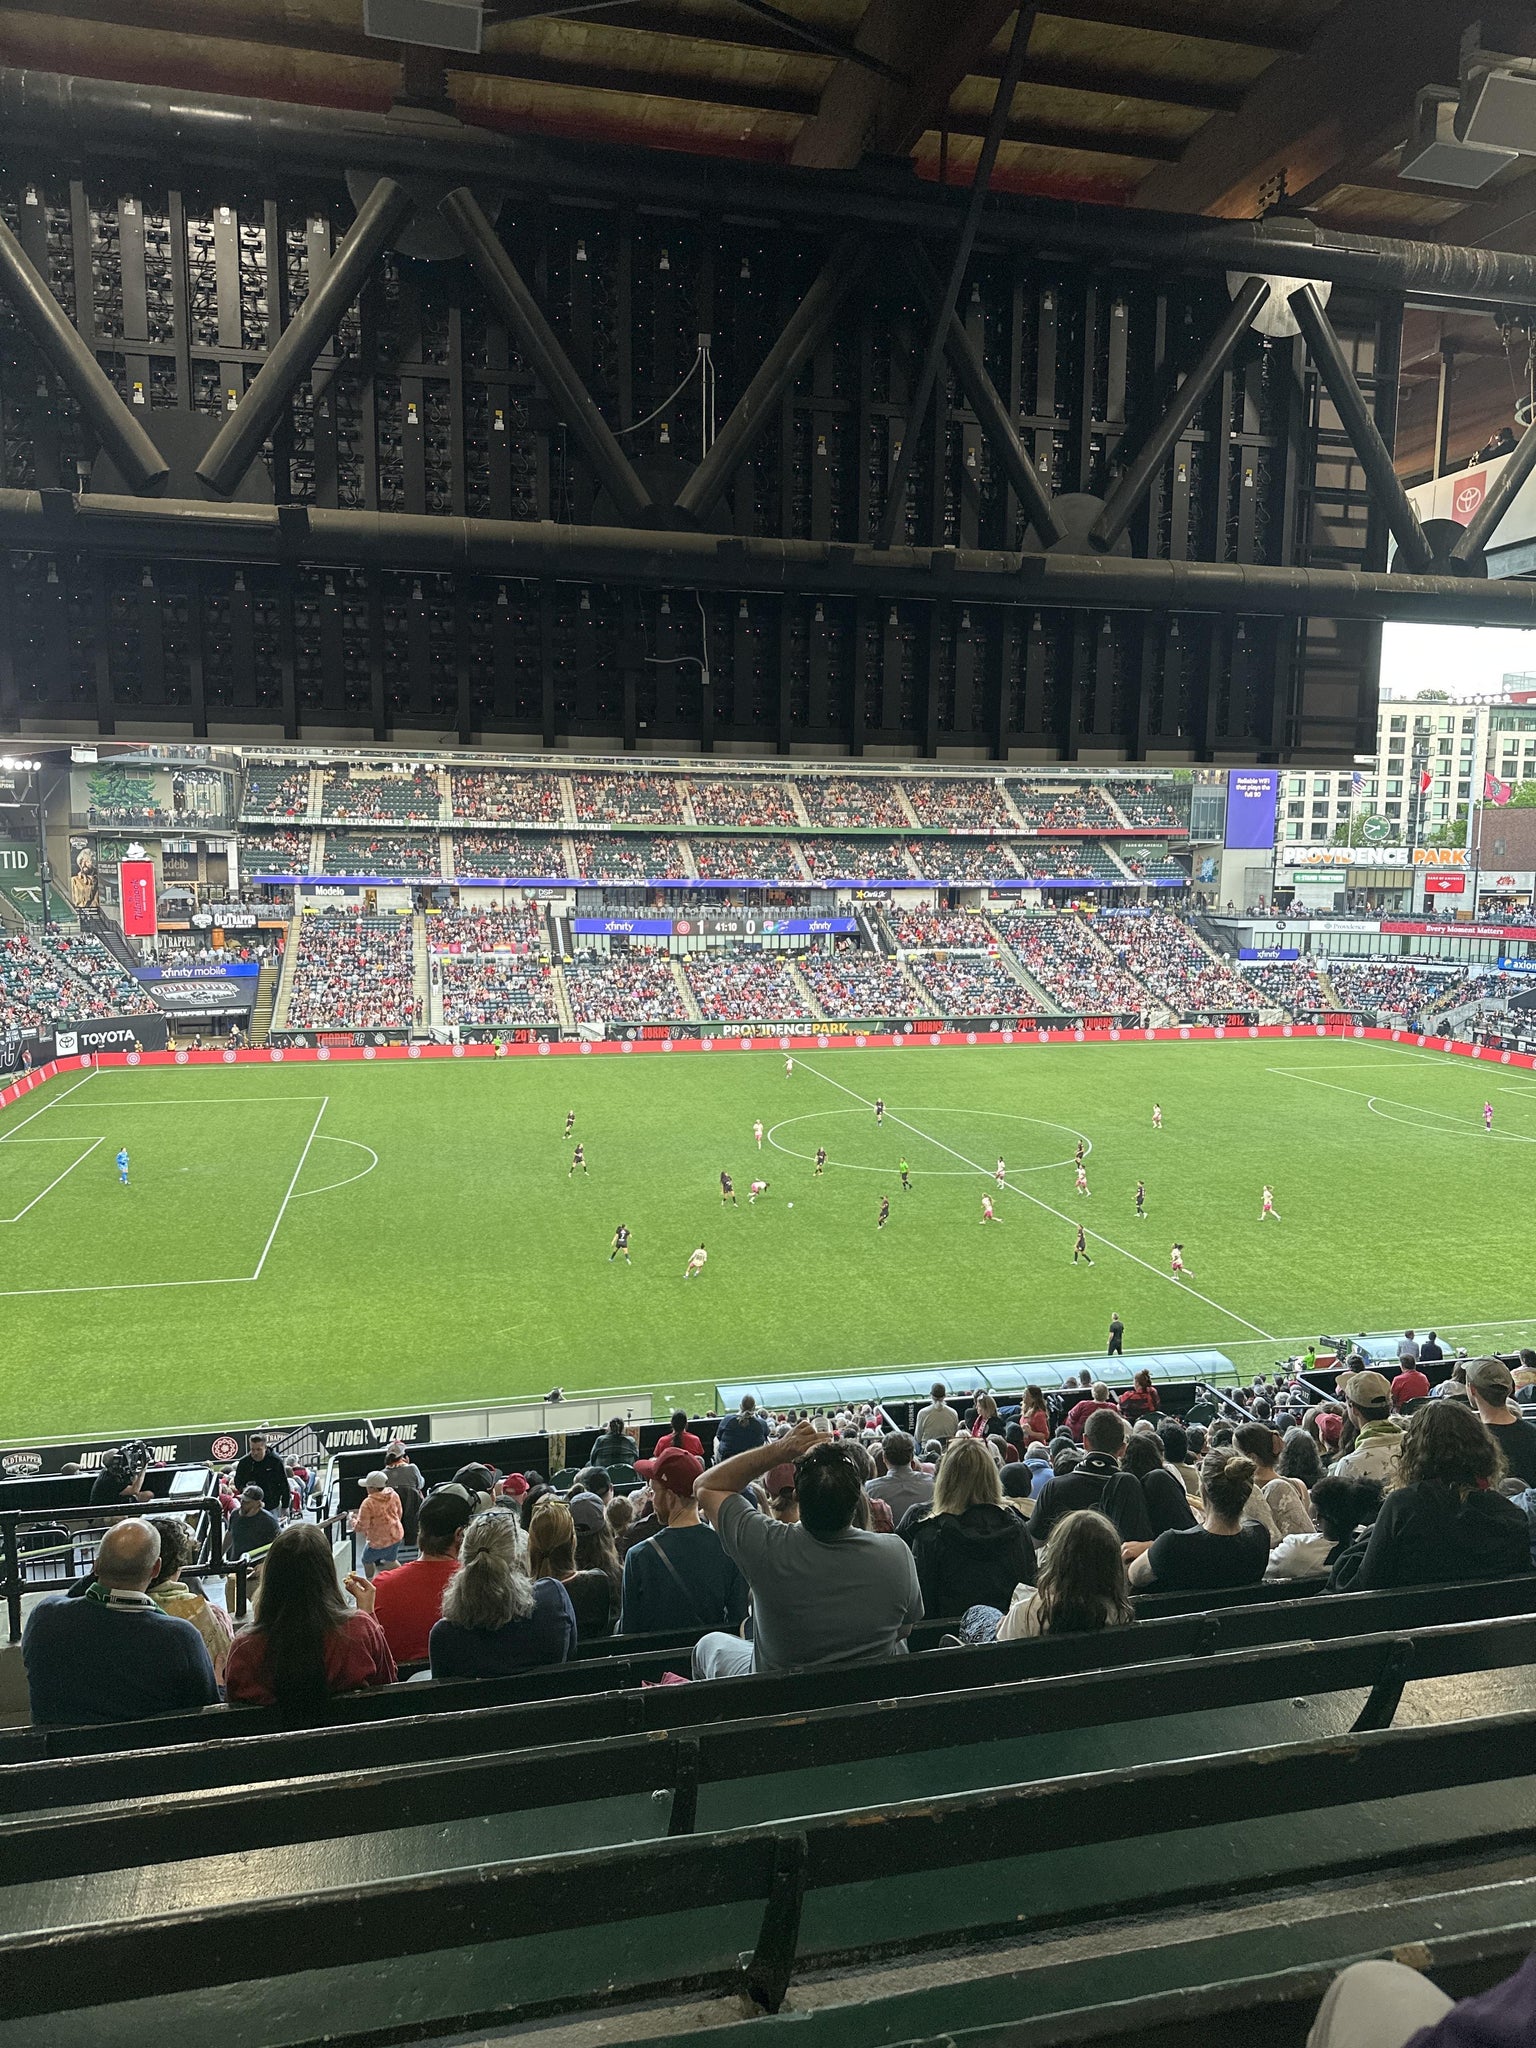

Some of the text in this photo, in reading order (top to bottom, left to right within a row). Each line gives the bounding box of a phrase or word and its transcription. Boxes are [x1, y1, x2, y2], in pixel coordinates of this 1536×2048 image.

[1283, 847, 1469, 865] PROVIDENCE PARK
[163, 858, 188, 870] odelo
[315, 886, 345, 896] Modelo
[605, 921, 634, 932] xfinity
[697, 920, 755, 934] 1 41:10 0
[809, 921, 831, 932] xfinity
[1426, 925, 1504, 935] Every Moment Matters
[1257, 950, 1280, 959] xfinity
[161, 966, 227, 978] xfinity mobile
[1018, 1019, 1036, 1029] 2012
[1227, 1014, 1245, 1025] 2012
[638, 1026, 670, 1039] HORNS
[723, 1023, 848, 1036] PROVIDENCE PARK
[913, 1021, 942, 1033] THORNS
[81, 1029, 135, 1046] TOYOTA
[389, 1424, 418, 1441] ZONE
